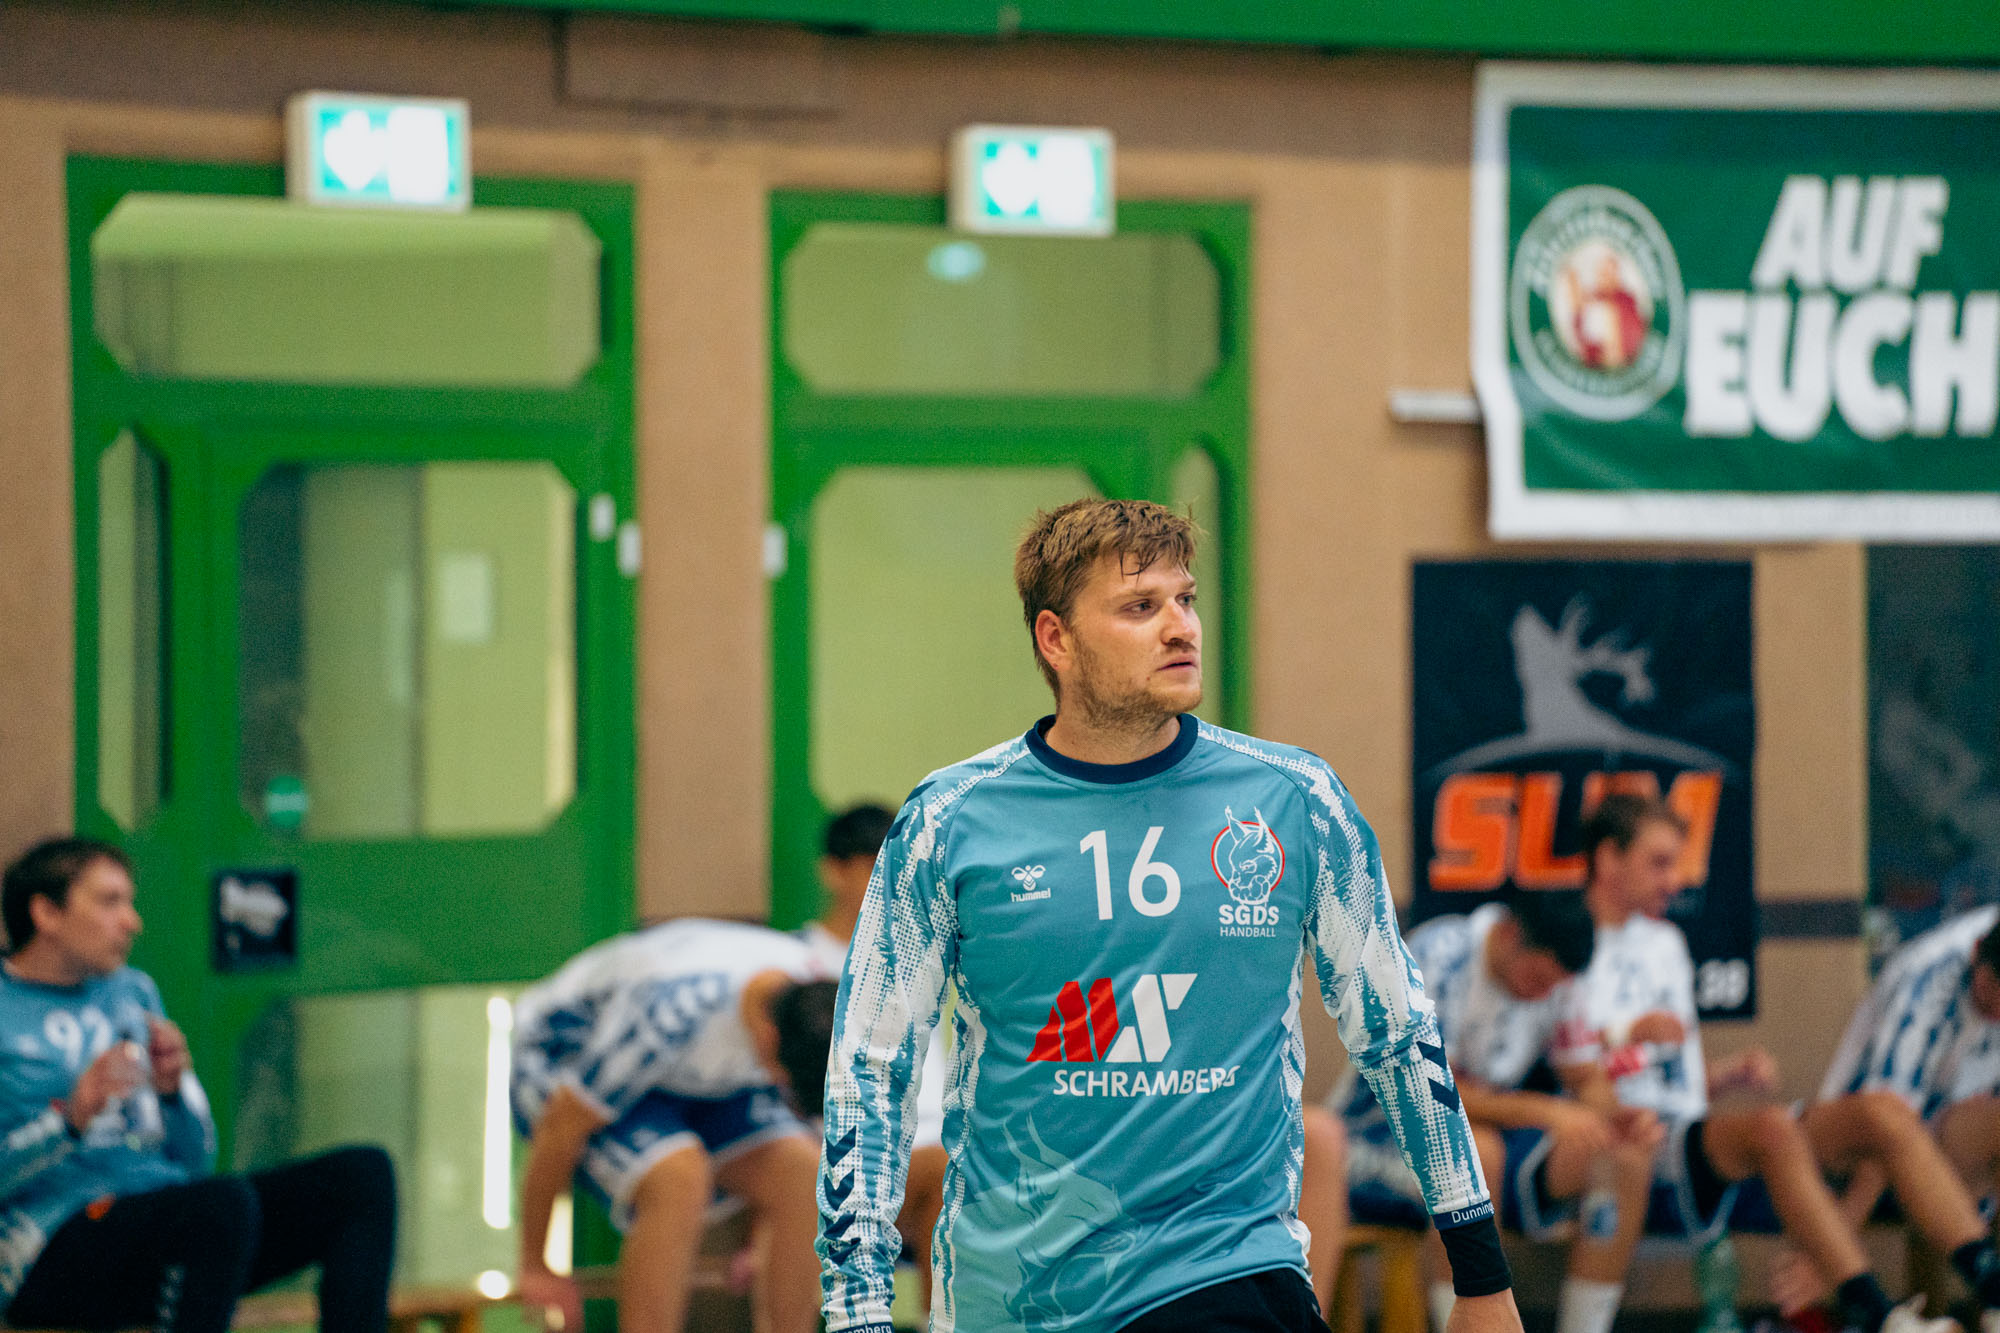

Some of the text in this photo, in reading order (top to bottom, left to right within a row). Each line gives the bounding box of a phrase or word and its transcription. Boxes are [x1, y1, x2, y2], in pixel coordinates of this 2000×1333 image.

[1753, 174, 1949, 292] AUF
[1685, 290, 1998, 440] EUCH
[1079, 826, 1181, 920] 16
[1010, 887, 1051, 902] hummel
[1219, 904, 1279, 926] SGDS
[1219, 926, 1276, 938] HANDBALL
[1053, 1065, 1241, 1097] SCHRAMBERG
